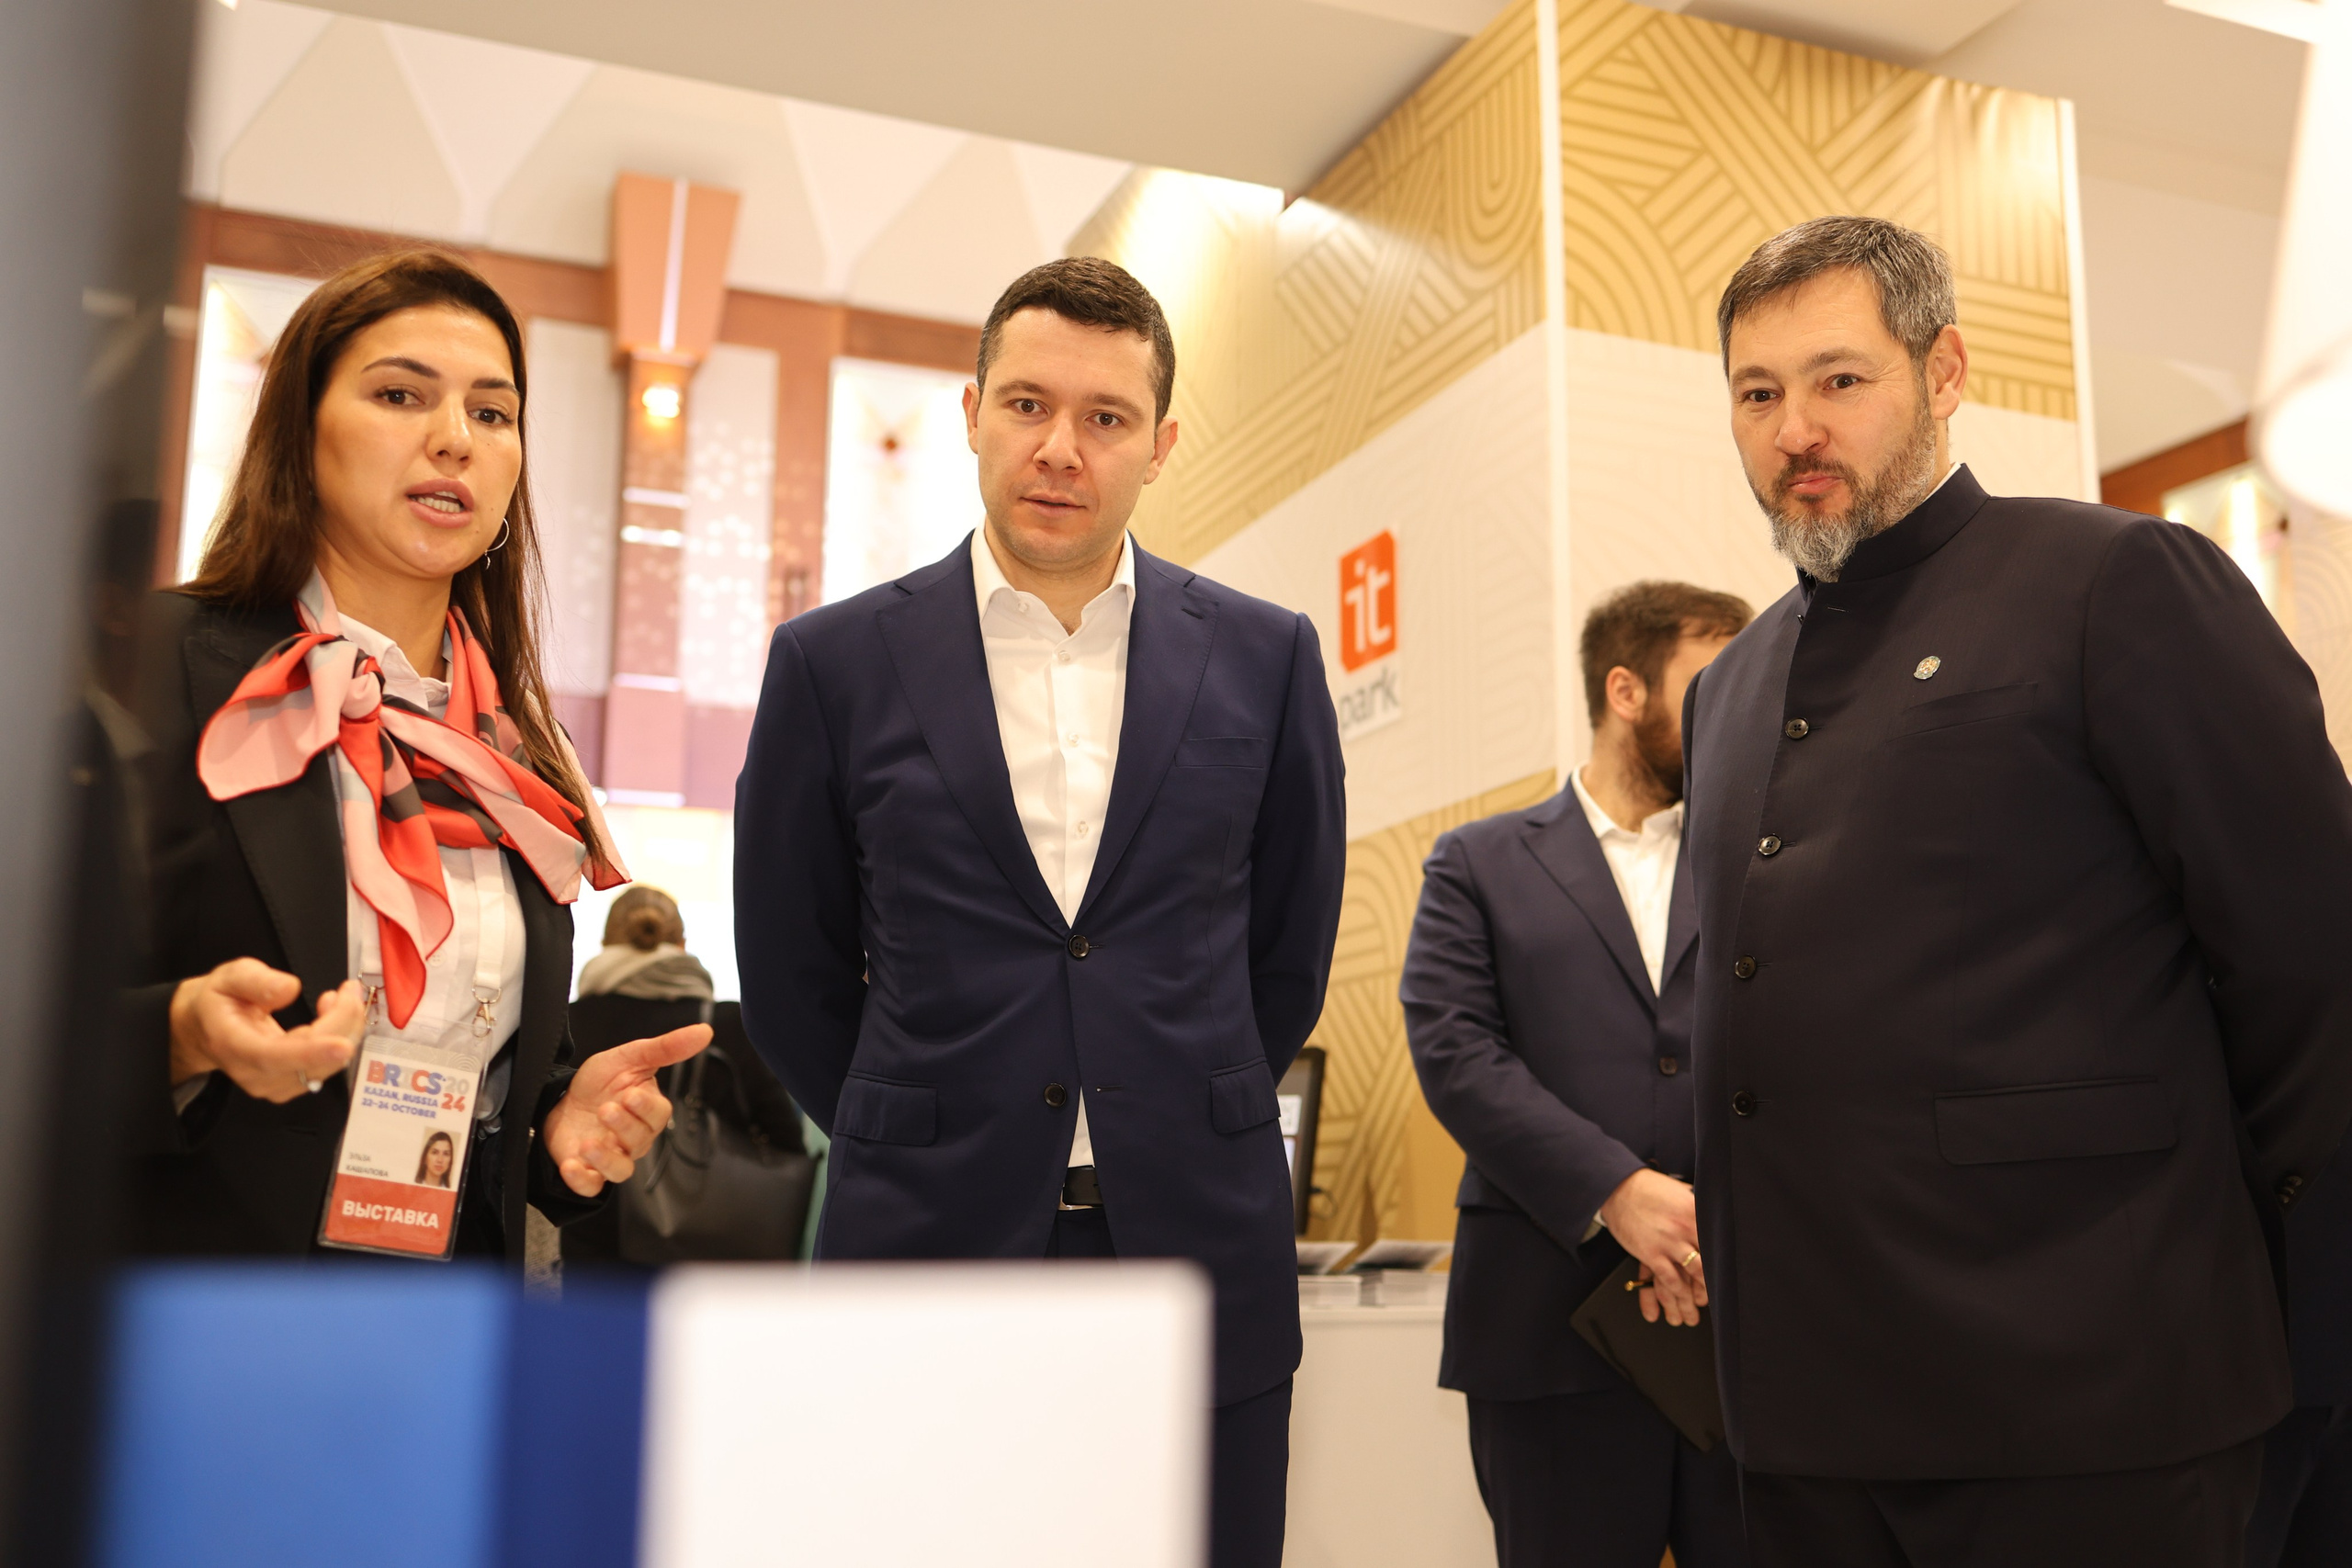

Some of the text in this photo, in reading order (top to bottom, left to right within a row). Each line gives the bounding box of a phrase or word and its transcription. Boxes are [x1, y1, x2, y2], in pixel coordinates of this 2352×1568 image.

[1345, 558, 1392, 653] it
[1340, 667, 1399, 731] park
[367, 1060, 442, 1095] BRICS
[364, 1086, 438, 1107] KAZAN, RUSSIA
[441, 1093, 465, 1112] 24
[391, 1104, 436, 1119] OCTOBER
[342, 1200, 439, 1229] ВЫСТАВКА
